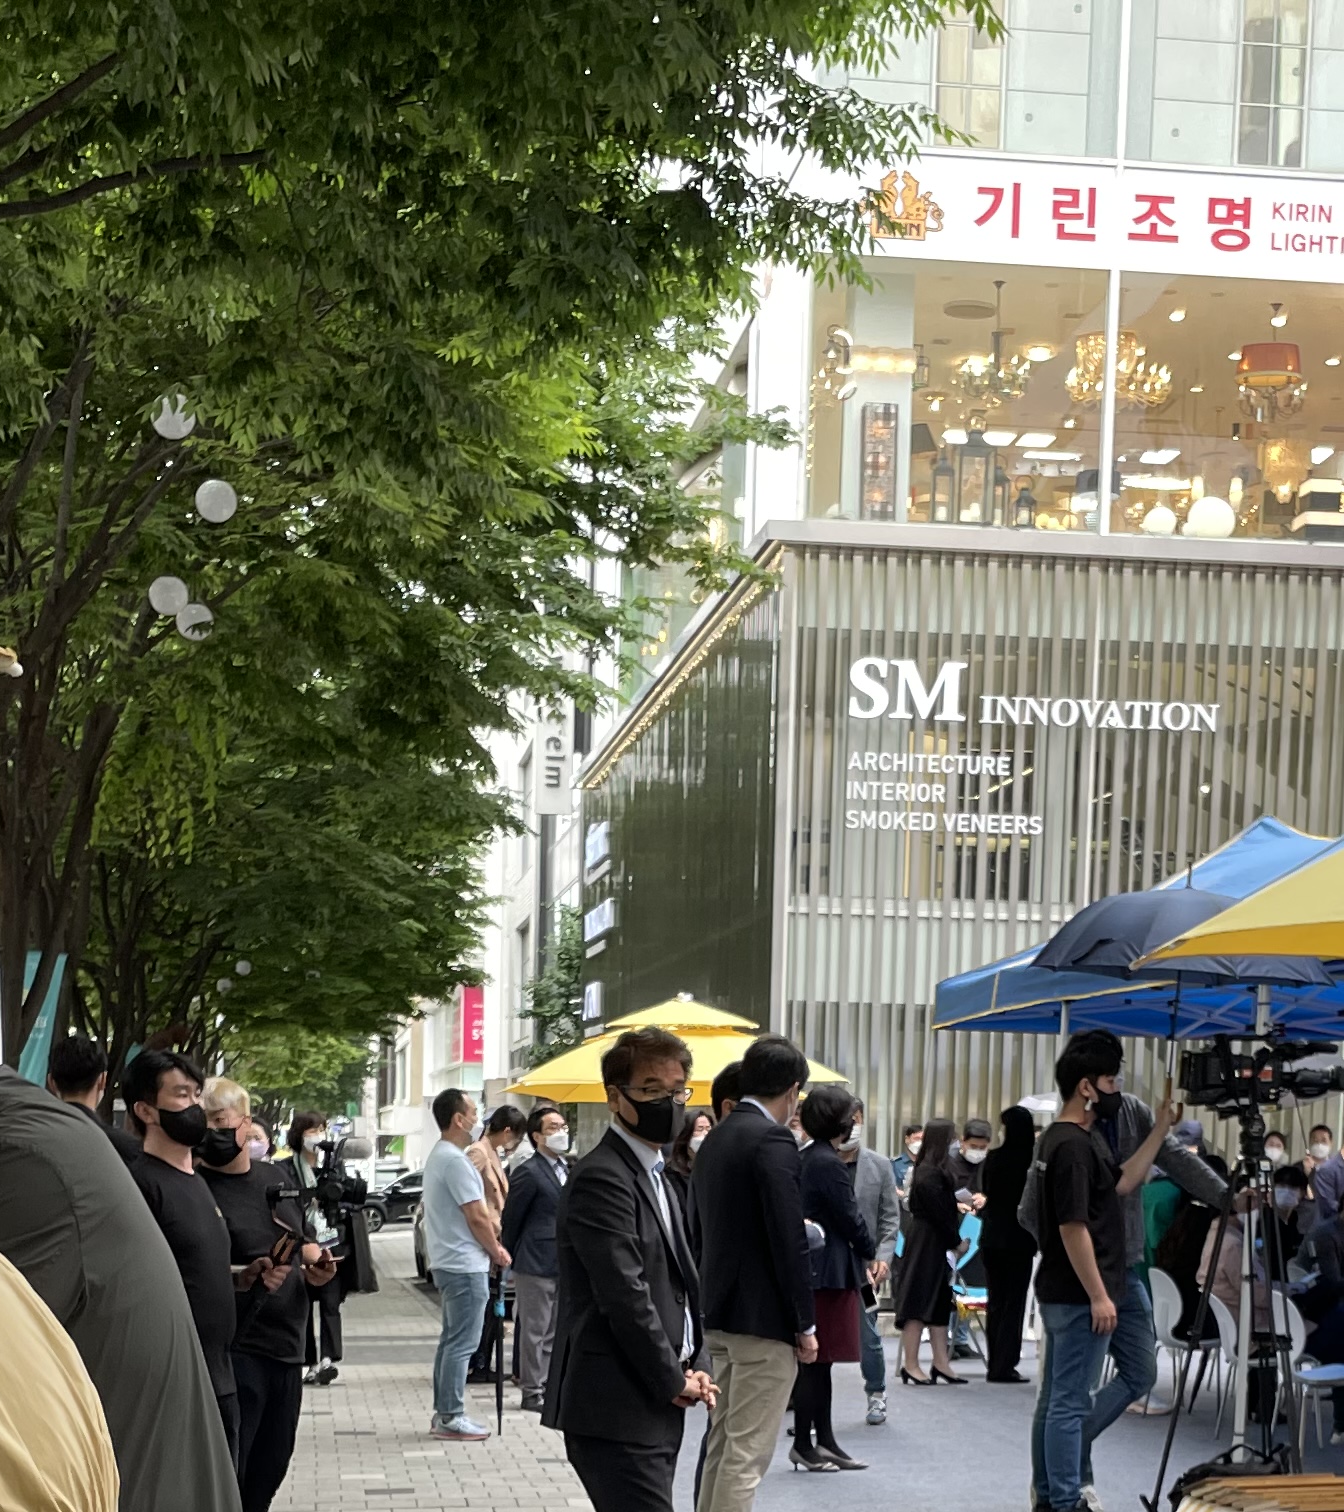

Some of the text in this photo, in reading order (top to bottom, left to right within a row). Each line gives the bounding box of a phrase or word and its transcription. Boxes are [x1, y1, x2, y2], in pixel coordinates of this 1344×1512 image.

[974, 183, 1252, 252] 기린조명
[1271, 202, 1333, 224] KIRIN
[848, 656, 1220, 732] SM INNOVATION
[848, 751, 1012, 777] ARCHITECTURE
[846, 780, 946, 804] INTERIOR
[846, 810, 1044, 836] SMOKED VENEERS
